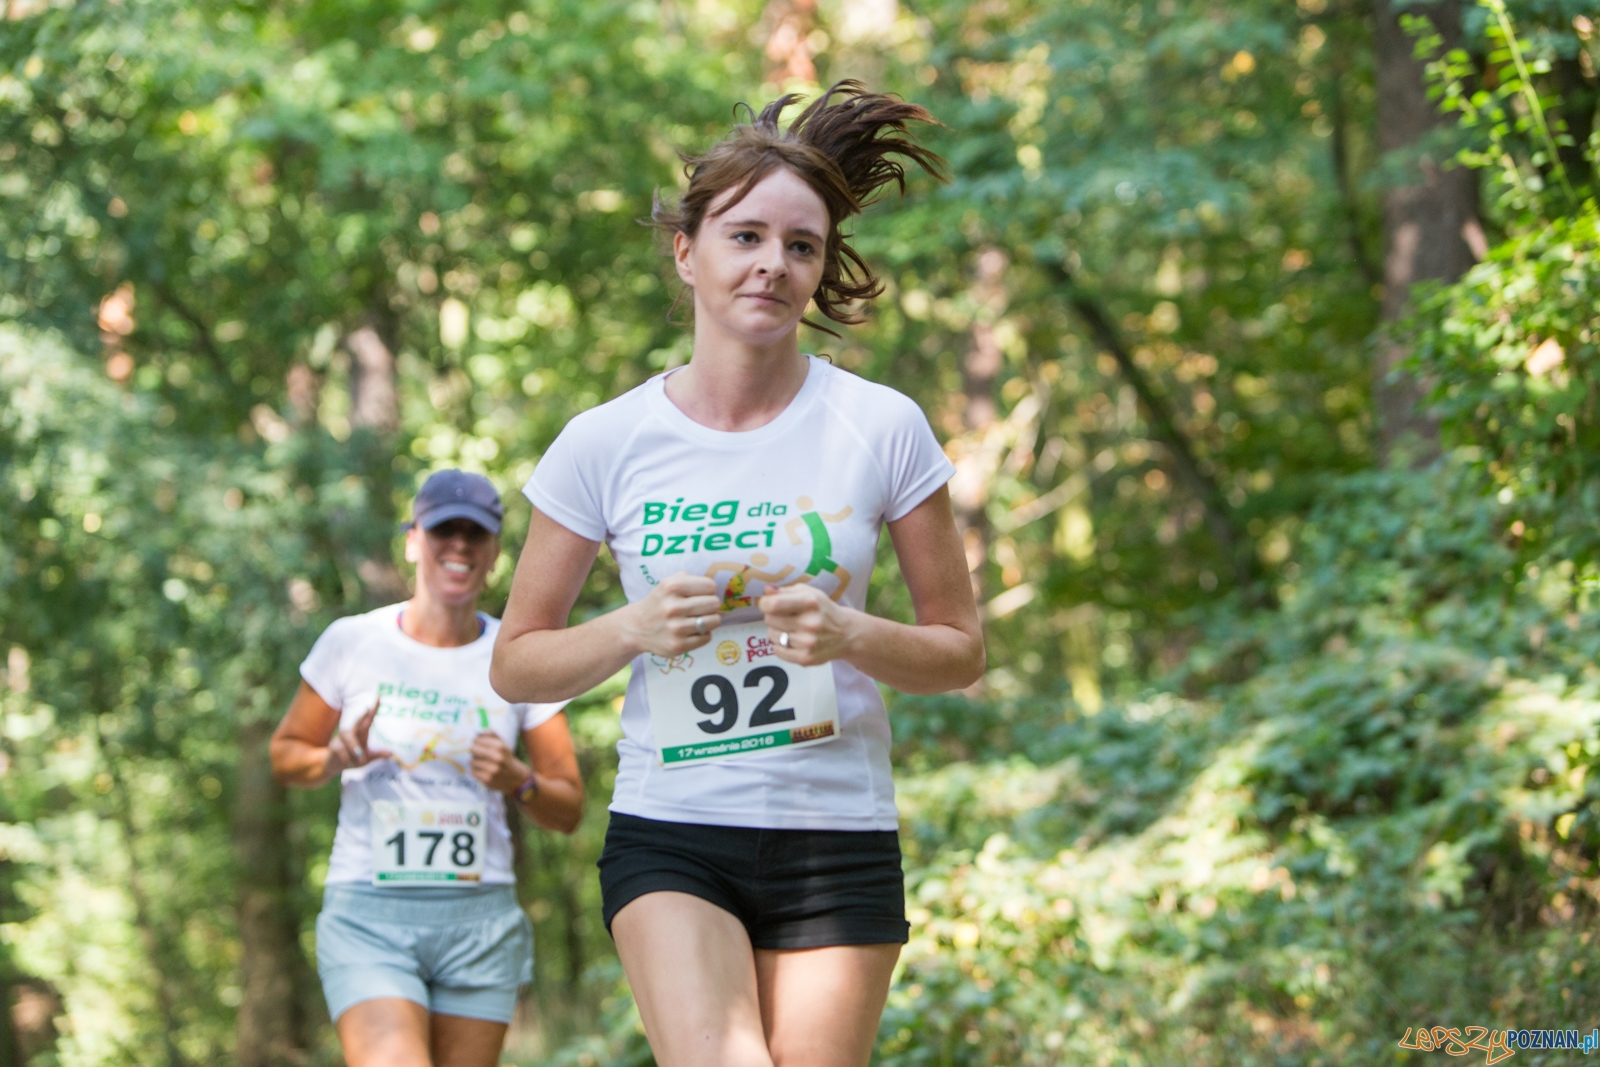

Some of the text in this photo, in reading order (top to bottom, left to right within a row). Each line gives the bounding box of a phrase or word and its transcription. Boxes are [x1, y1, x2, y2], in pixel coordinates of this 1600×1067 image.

[641, 497, 788, 527] Bieg dla
[641, 521, 777, 557] Dzieci
[690, 665, 796, 735] 92
[677, 748, 693, 759] 17
[741, 735, 775, 749] 2016
[386, 831, 475, 867] 178
